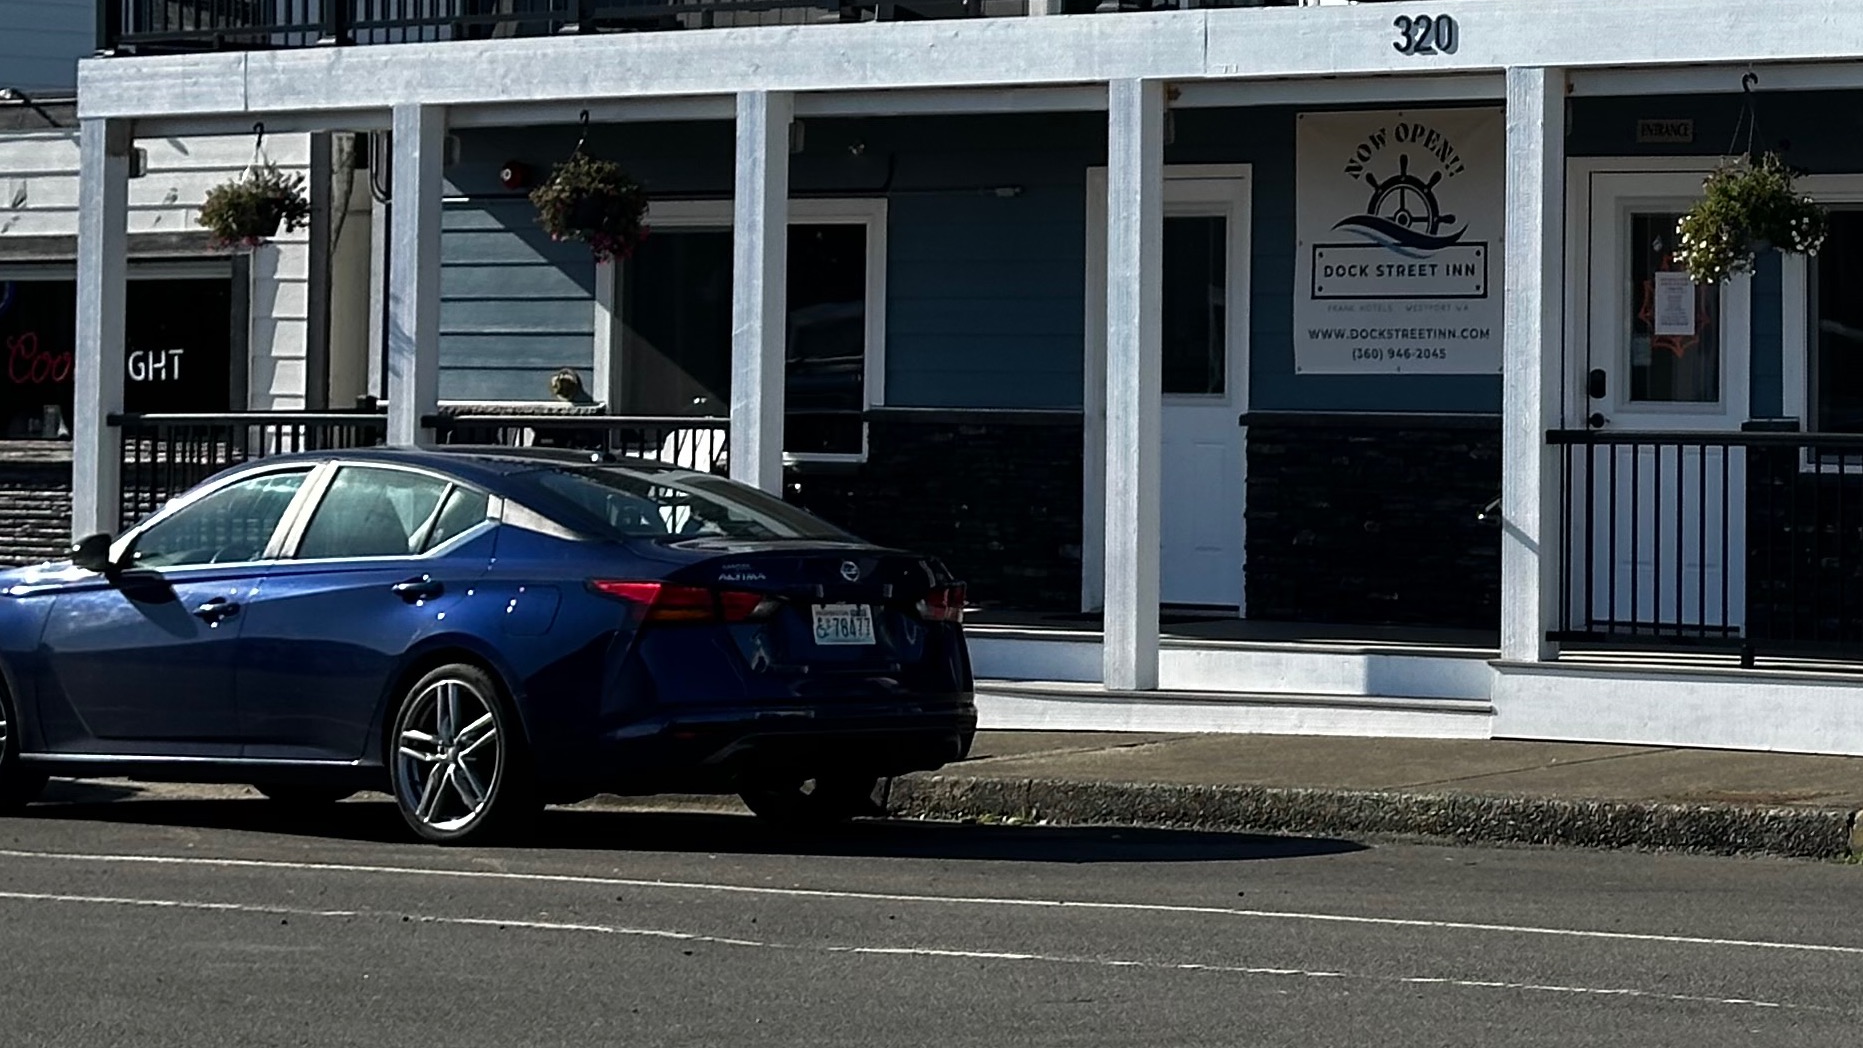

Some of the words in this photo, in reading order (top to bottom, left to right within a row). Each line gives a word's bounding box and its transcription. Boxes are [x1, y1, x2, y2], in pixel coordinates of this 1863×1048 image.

[1393, 14, 1455, 54] 320
[1641, 123, 1690, 137] ENTRANCE
[1344, 127, 1388, 180] NOW
[1394, 122, 1465, 178] OPEN!!
[1323, 264, 1369, 279] DOCK
[1375, 263, 1439, 278] STREET
[1445, 262, 1476, 277] INN
[1308, 327, 1491, 340] WWW.DOCKSTREETINN.COM
[6, 330, 74, 384] Coo
[127, 349, 184, 382] GHT
[1352, 348, 1384, 361] (360)
[1387, 348, 1447, 360] 946-2045
